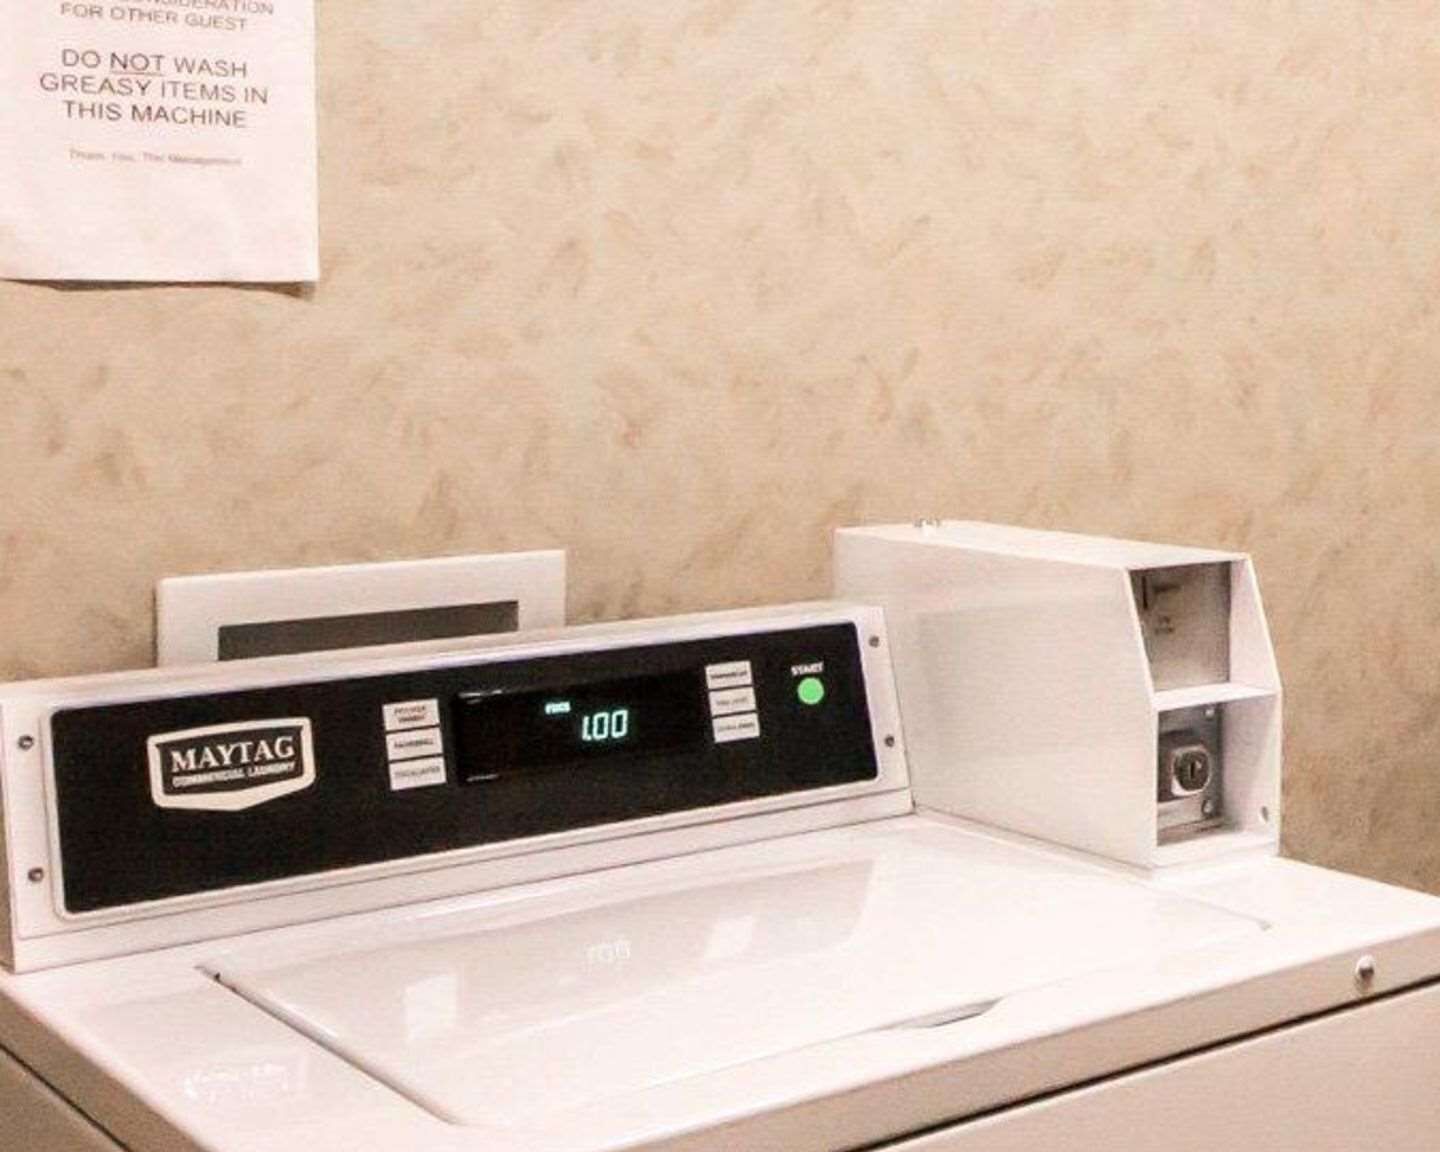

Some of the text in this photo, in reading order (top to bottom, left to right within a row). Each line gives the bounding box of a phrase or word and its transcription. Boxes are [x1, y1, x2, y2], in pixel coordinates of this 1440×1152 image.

[60, 3, 248, 31] FOR OTHER GUEST
[61, 49, 247, 78] DO NOT WASH
[39, 73, 268, 104] GREASY ITEMS IN
[63, 100, 248, 128] THIS MACHINE
[171, 735, 295, 773] MAYTAG
